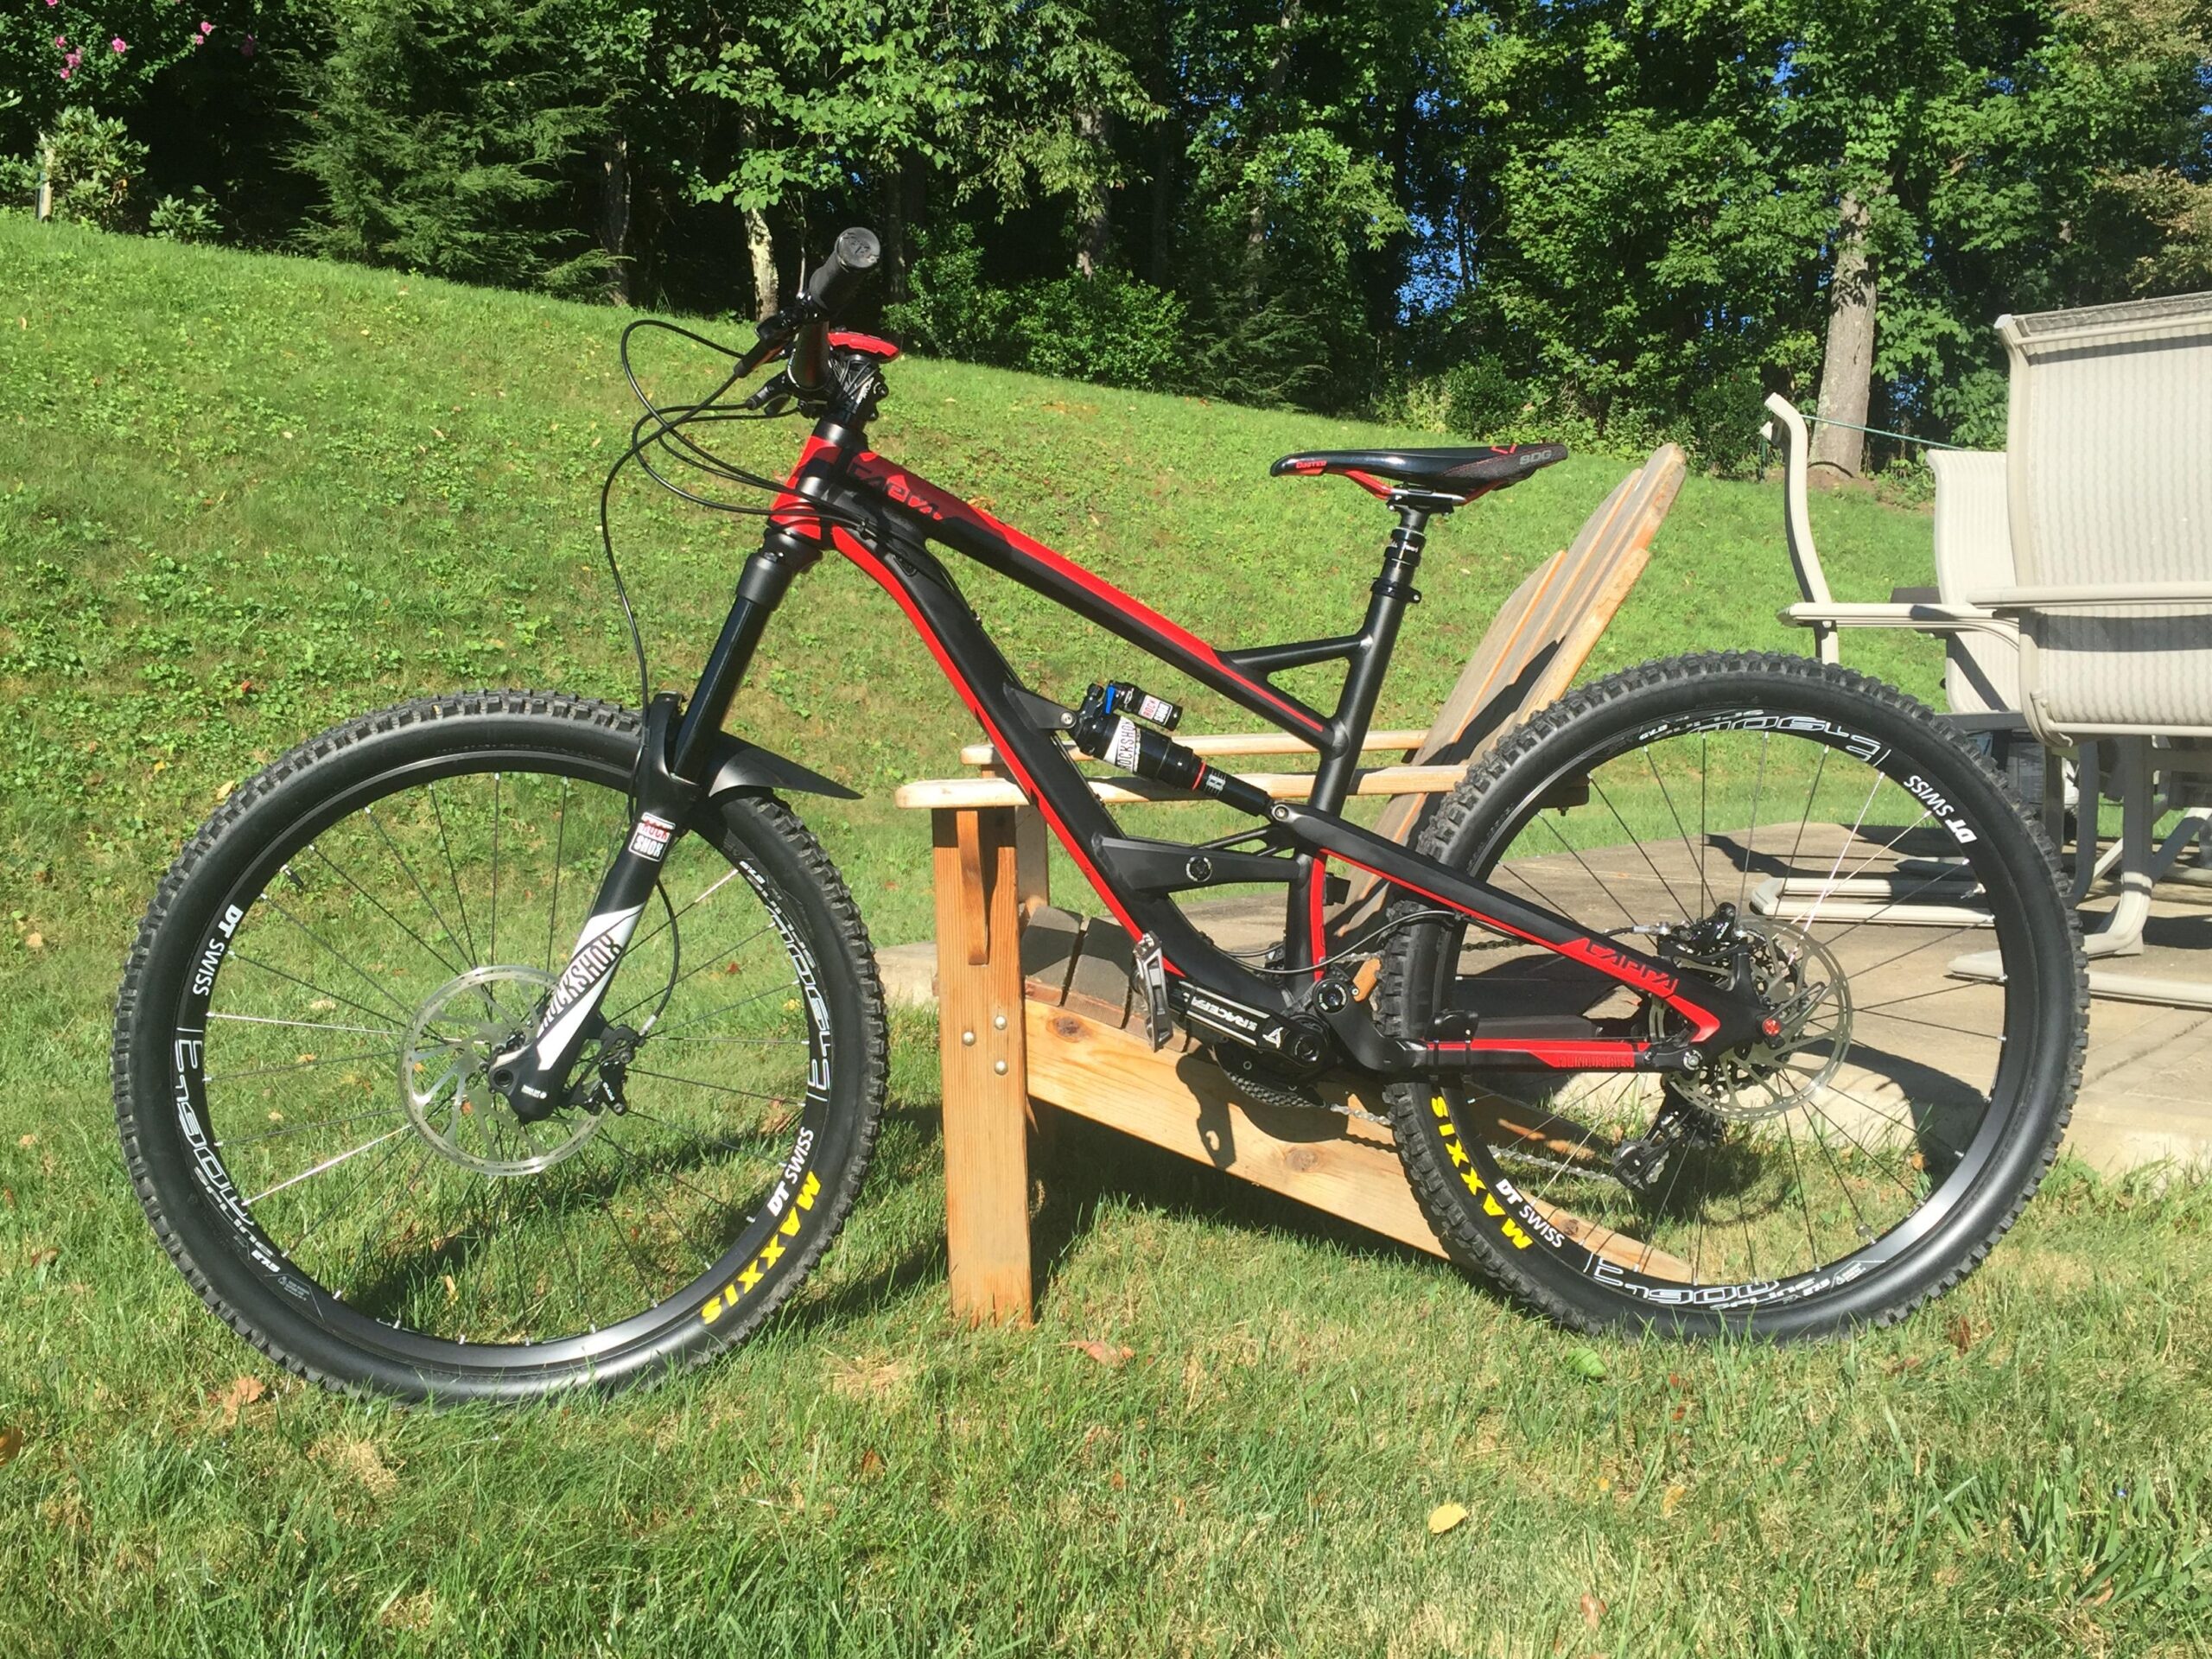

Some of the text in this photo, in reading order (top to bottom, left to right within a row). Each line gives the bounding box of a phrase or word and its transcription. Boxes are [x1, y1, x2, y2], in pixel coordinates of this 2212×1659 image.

[1520, 449, 1552, 465] SDG
[1904, 775, 1978, 843] DT SWISS
[193, 904, 244, 995] DT SWISS
[767, 1127, 814, 1217] DT SWISS
[1431, 1096, 1533, 1249] MAXXIS
[1495, 1178, 1565, 1248] DT SWISS
[701, 1171, 822, 1325] MAXXIS
